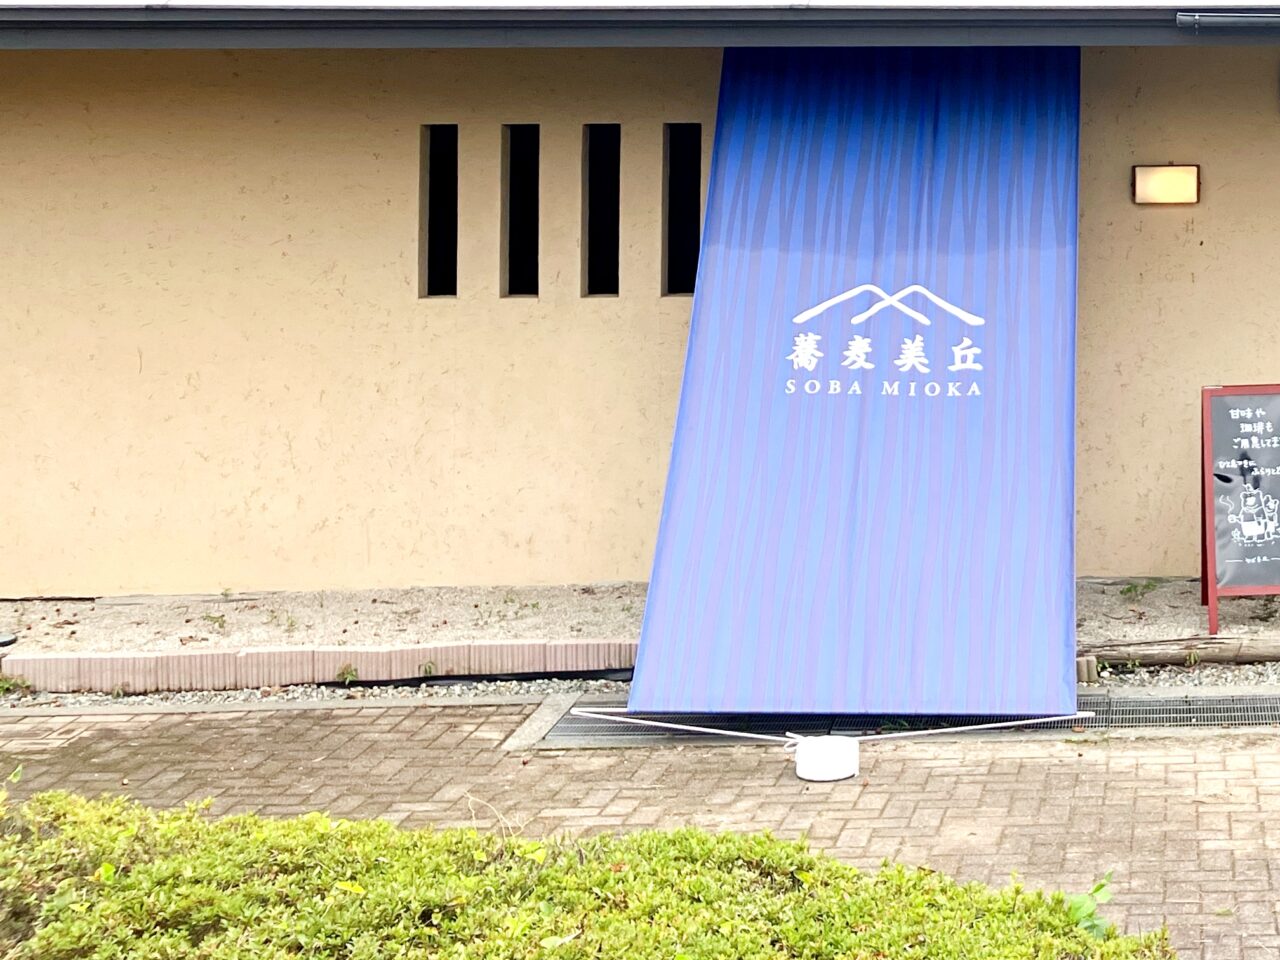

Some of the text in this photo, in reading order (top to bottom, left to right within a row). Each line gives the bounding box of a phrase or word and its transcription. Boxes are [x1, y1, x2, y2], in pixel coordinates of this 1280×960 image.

[785, 332, 984, 373] 蕎麦美丘
[785, 379, 982, 397] SOBA MIOKA
